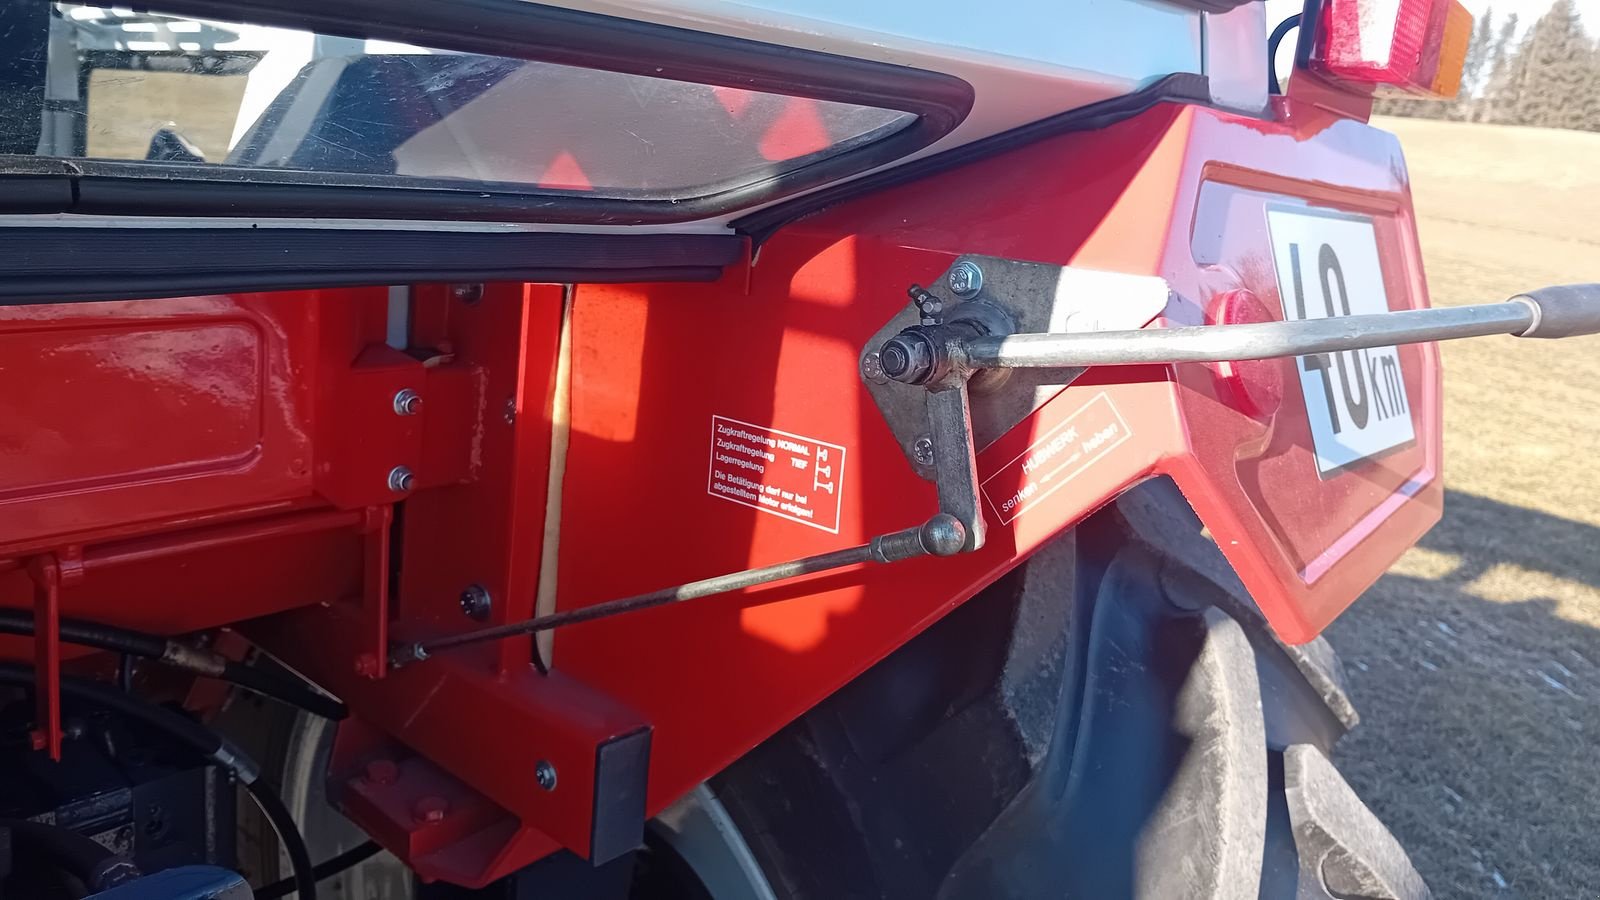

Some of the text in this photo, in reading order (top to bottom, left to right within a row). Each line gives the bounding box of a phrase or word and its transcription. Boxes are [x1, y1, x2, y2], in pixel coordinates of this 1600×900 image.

[1289, 243, 1406, 434] 40 km
[716, 438, 809, 470] Zugkraftregelung TIEF
[717, 424, 810, 456] Zugkraftregelung NORMAL
[1022, 426, 1079, 475] HUBWERK
[716, 452, 765, 474] Lagerregelung
[1001, 423, 1118, 512] senken heben
[713, 482, 814, 519] abgestelltem Motor erfolgen!
[714, 470, 726, 480] Die
[727, 474, 765, 493] Betätigung
[781, 491, 795, 501] nur
[795, 493, 808, 505] bei
